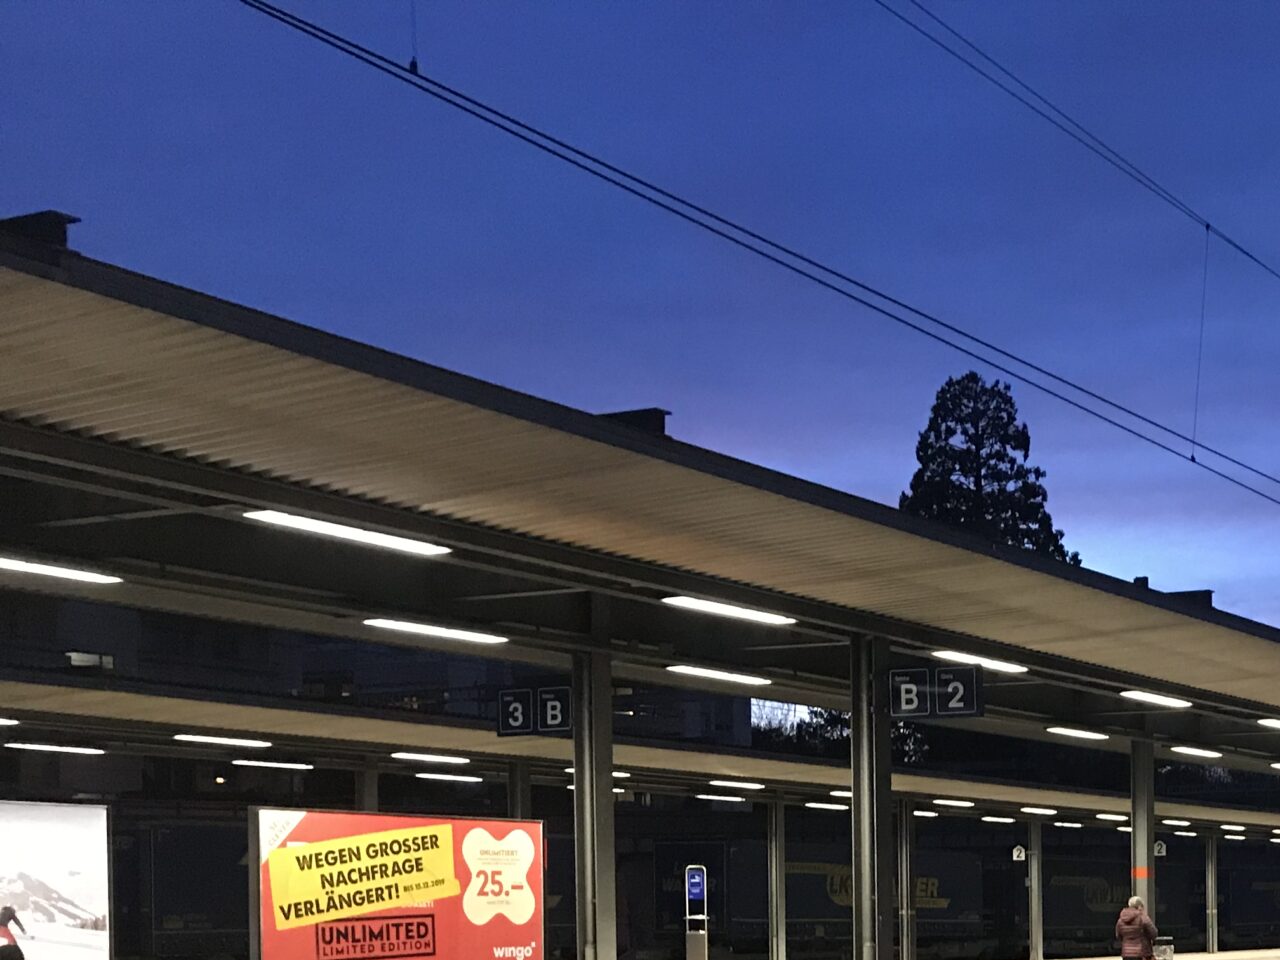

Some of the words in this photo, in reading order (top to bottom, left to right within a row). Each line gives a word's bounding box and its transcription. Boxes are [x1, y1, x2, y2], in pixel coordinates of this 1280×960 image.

[901, 684, 918, 710] B
[947, 682, 964, 708] 2
[509, 702, 523, 726] 3
[547, 701, 562, 725] B
[296, 846, 361, 871] WEGEN
[366, 834, 439, 859] GROSSER
[1016, 847, 1022, 858] 2
[1157, 843, 1163, 854] 2
[320, 857, 424, 889] NACHFRAGE
[279, 883, 400, 921] VERLÄNGERT!
[321, 922, 429, 945] UNLIMITED
[322, 944, 375, 957] LIMITED
[381, 940, 431, 953] EDITION
